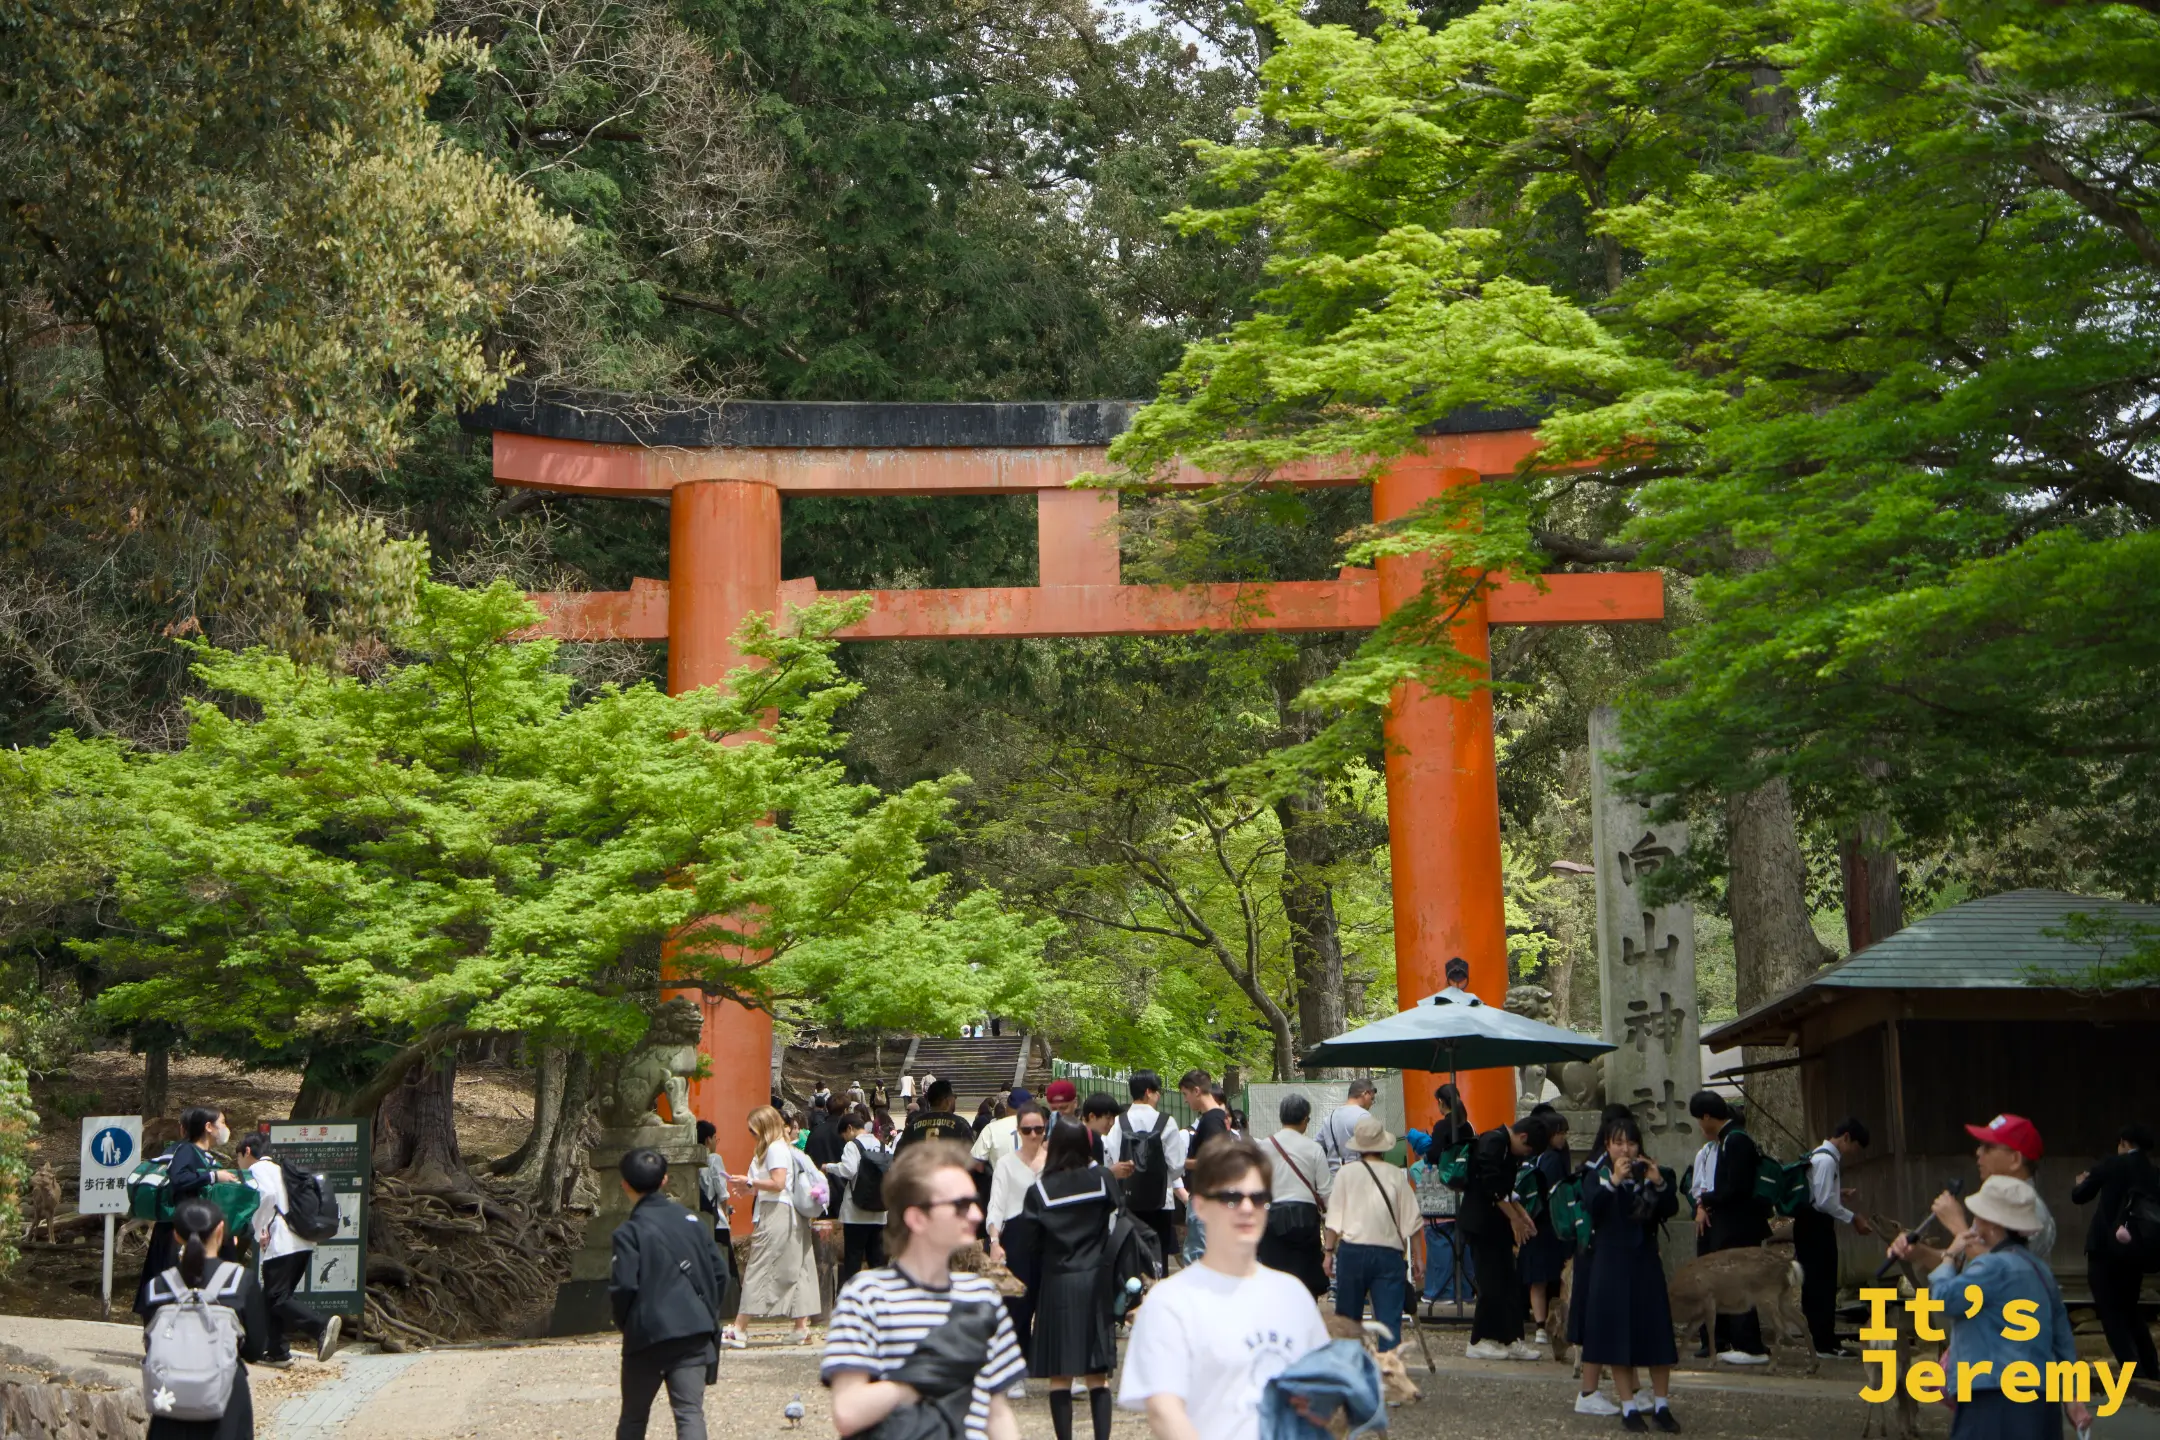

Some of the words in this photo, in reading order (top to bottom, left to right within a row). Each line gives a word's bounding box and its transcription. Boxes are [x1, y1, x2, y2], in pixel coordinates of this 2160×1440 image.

[1618, 799, 1692, 1136] 向山神社
[300, 1127, 328, 1136] 注意
[84, 1177, 127, 1191] 歩行者専
